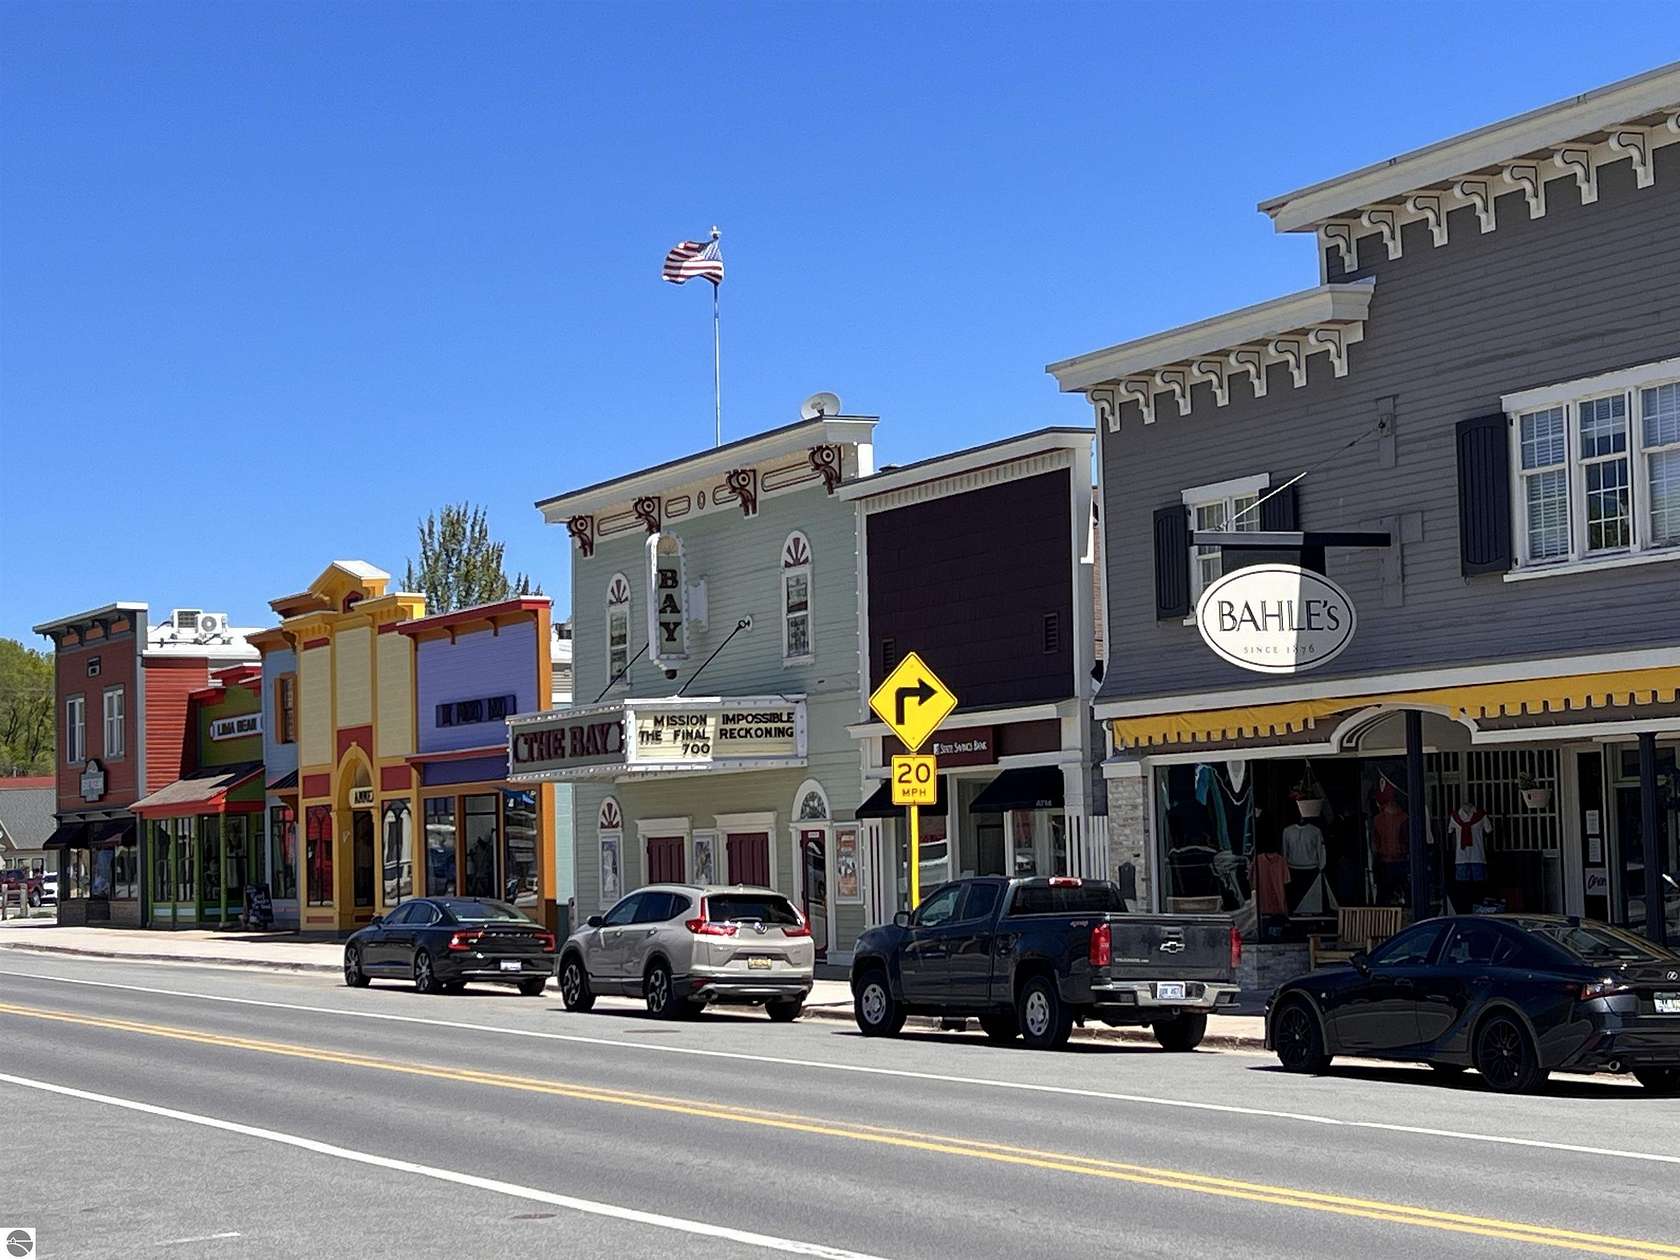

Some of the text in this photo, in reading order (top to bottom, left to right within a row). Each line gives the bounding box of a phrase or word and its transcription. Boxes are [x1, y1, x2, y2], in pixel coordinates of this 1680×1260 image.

[658, 569, 681, 642] BAY
[1218, 600, 1340, 632] BAHLE'S
[1244, 646, 1278, 655] SINCE
[653, 711, 795, 727] MISSION IMPOSSIBLE
[519, 722, 612, 762] THE BAY
[639, 726, 794, 743] THE FINAL RECKONING
[682, 743, 710, 755] 700
[898, 763, 930, 783] 20
[902, 788, 926, 797] MPH
